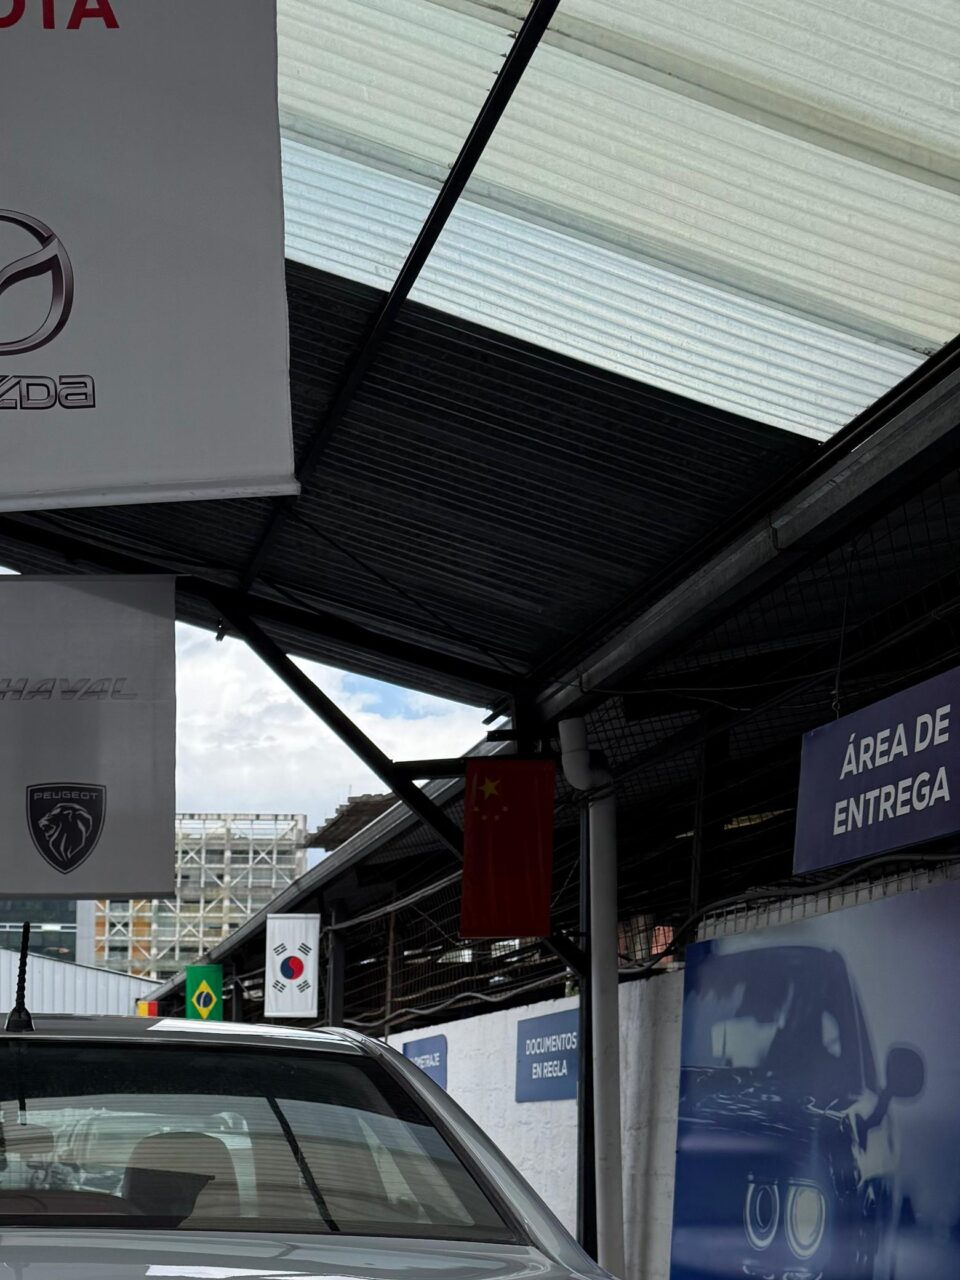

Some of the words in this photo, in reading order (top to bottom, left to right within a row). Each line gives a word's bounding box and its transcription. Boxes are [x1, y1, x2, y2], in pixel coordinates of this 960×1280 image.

[839, 722, 909, 780] ÁREA
[914, 704, 951, 753] DE
[33, 790, 99, 800] PEUGEOT
[832, 765, 951, 836] ENTREGA
[525, 1032, 578, 1055] DOCUMENTOS
[532, 1062, 542, 1079] EN
[543, 1059, 568, 1078] REGLA
